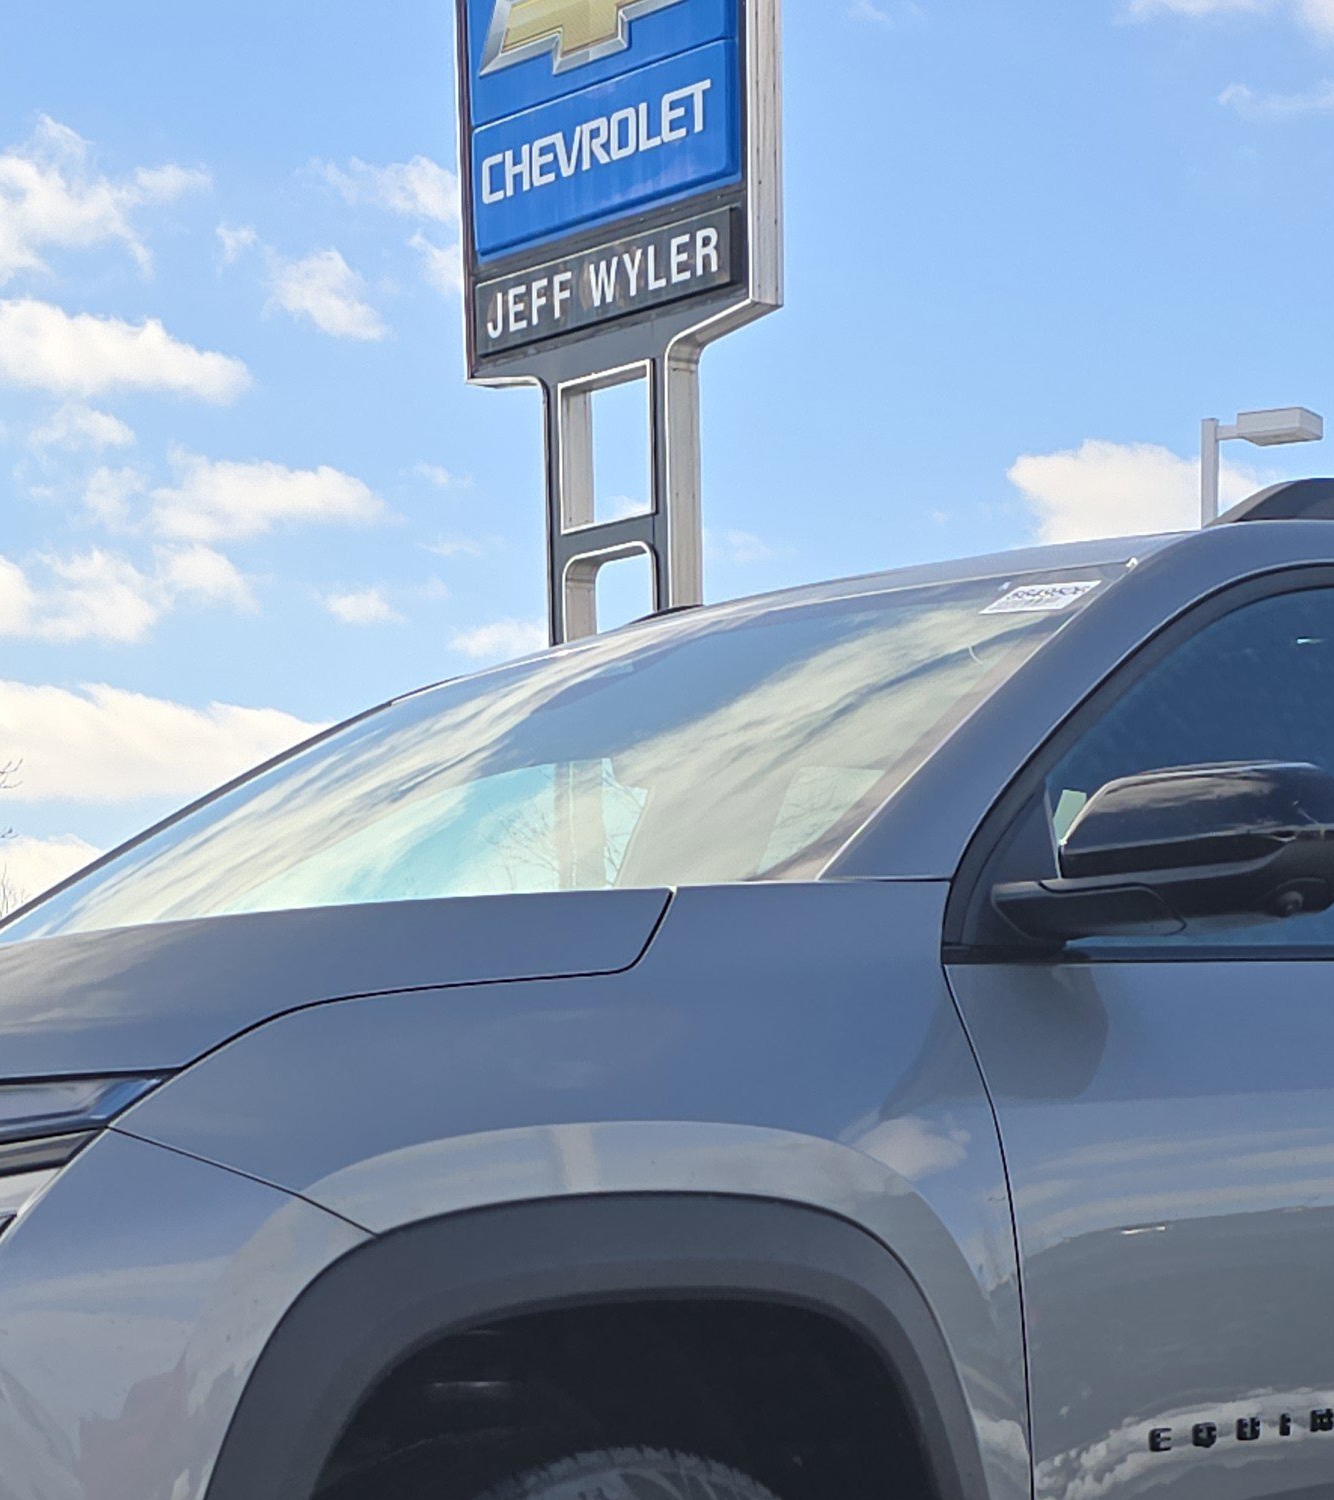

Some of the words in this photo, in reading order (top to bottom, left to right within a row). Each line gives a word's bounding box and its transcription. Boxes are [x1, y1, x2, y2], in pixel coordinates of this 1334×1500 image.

[481, 79, 711, 204] CHEVROLET
[487, 271, 572, 339] JEFF
[589, 227, 718, 307] WYLER
